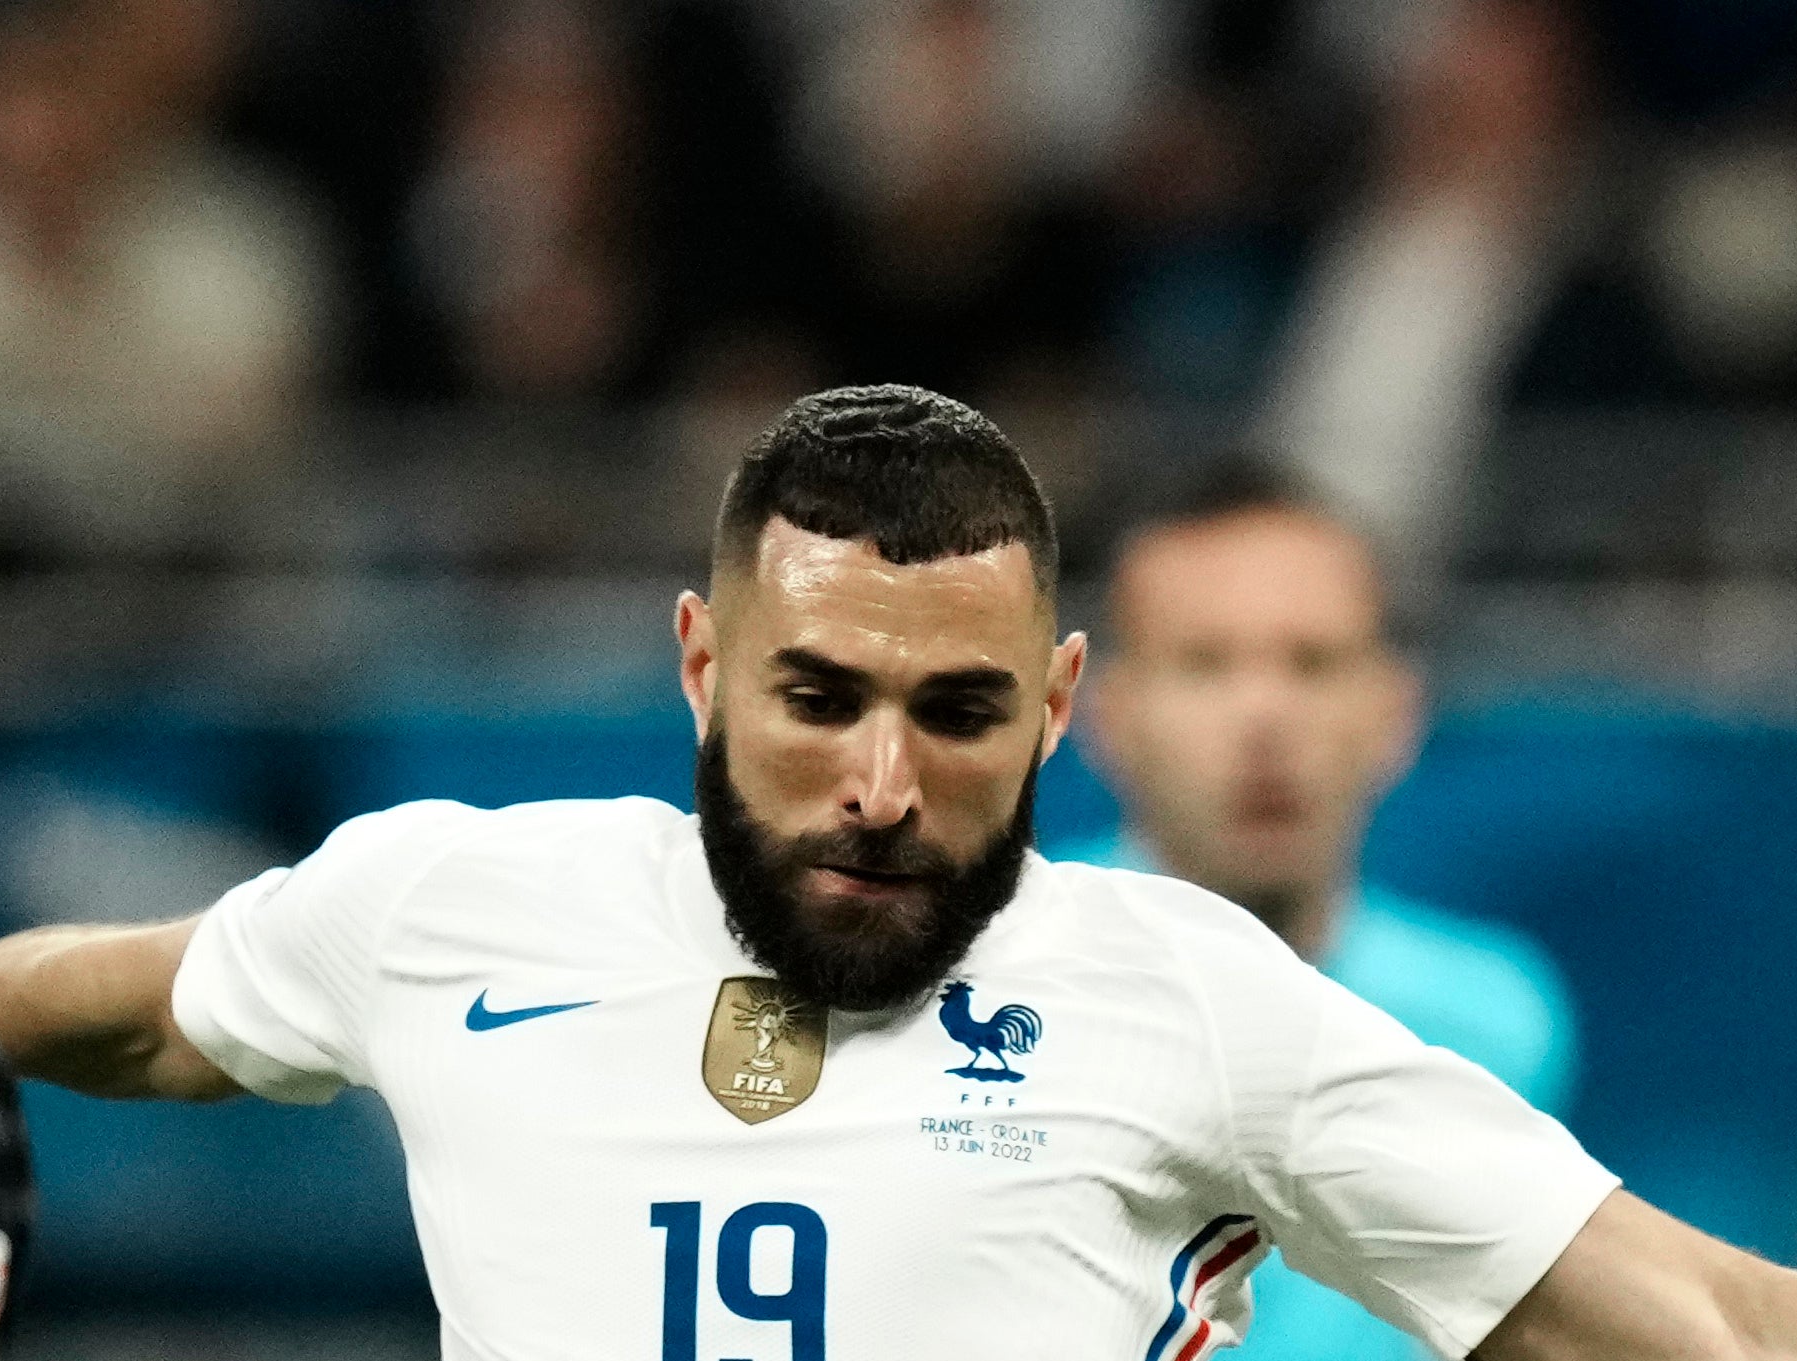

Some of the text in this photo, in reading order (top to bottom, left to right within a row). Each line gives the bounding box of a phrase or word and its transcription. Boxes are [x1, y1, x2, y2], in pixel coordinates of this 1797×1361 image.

[733, 1073, 784, 1095] FIFA
[921, 1117, 974, 1136] FRANCE
[934, 1136, 949, 1152] 13
[991, 1141, 1033, 1163] 2022
